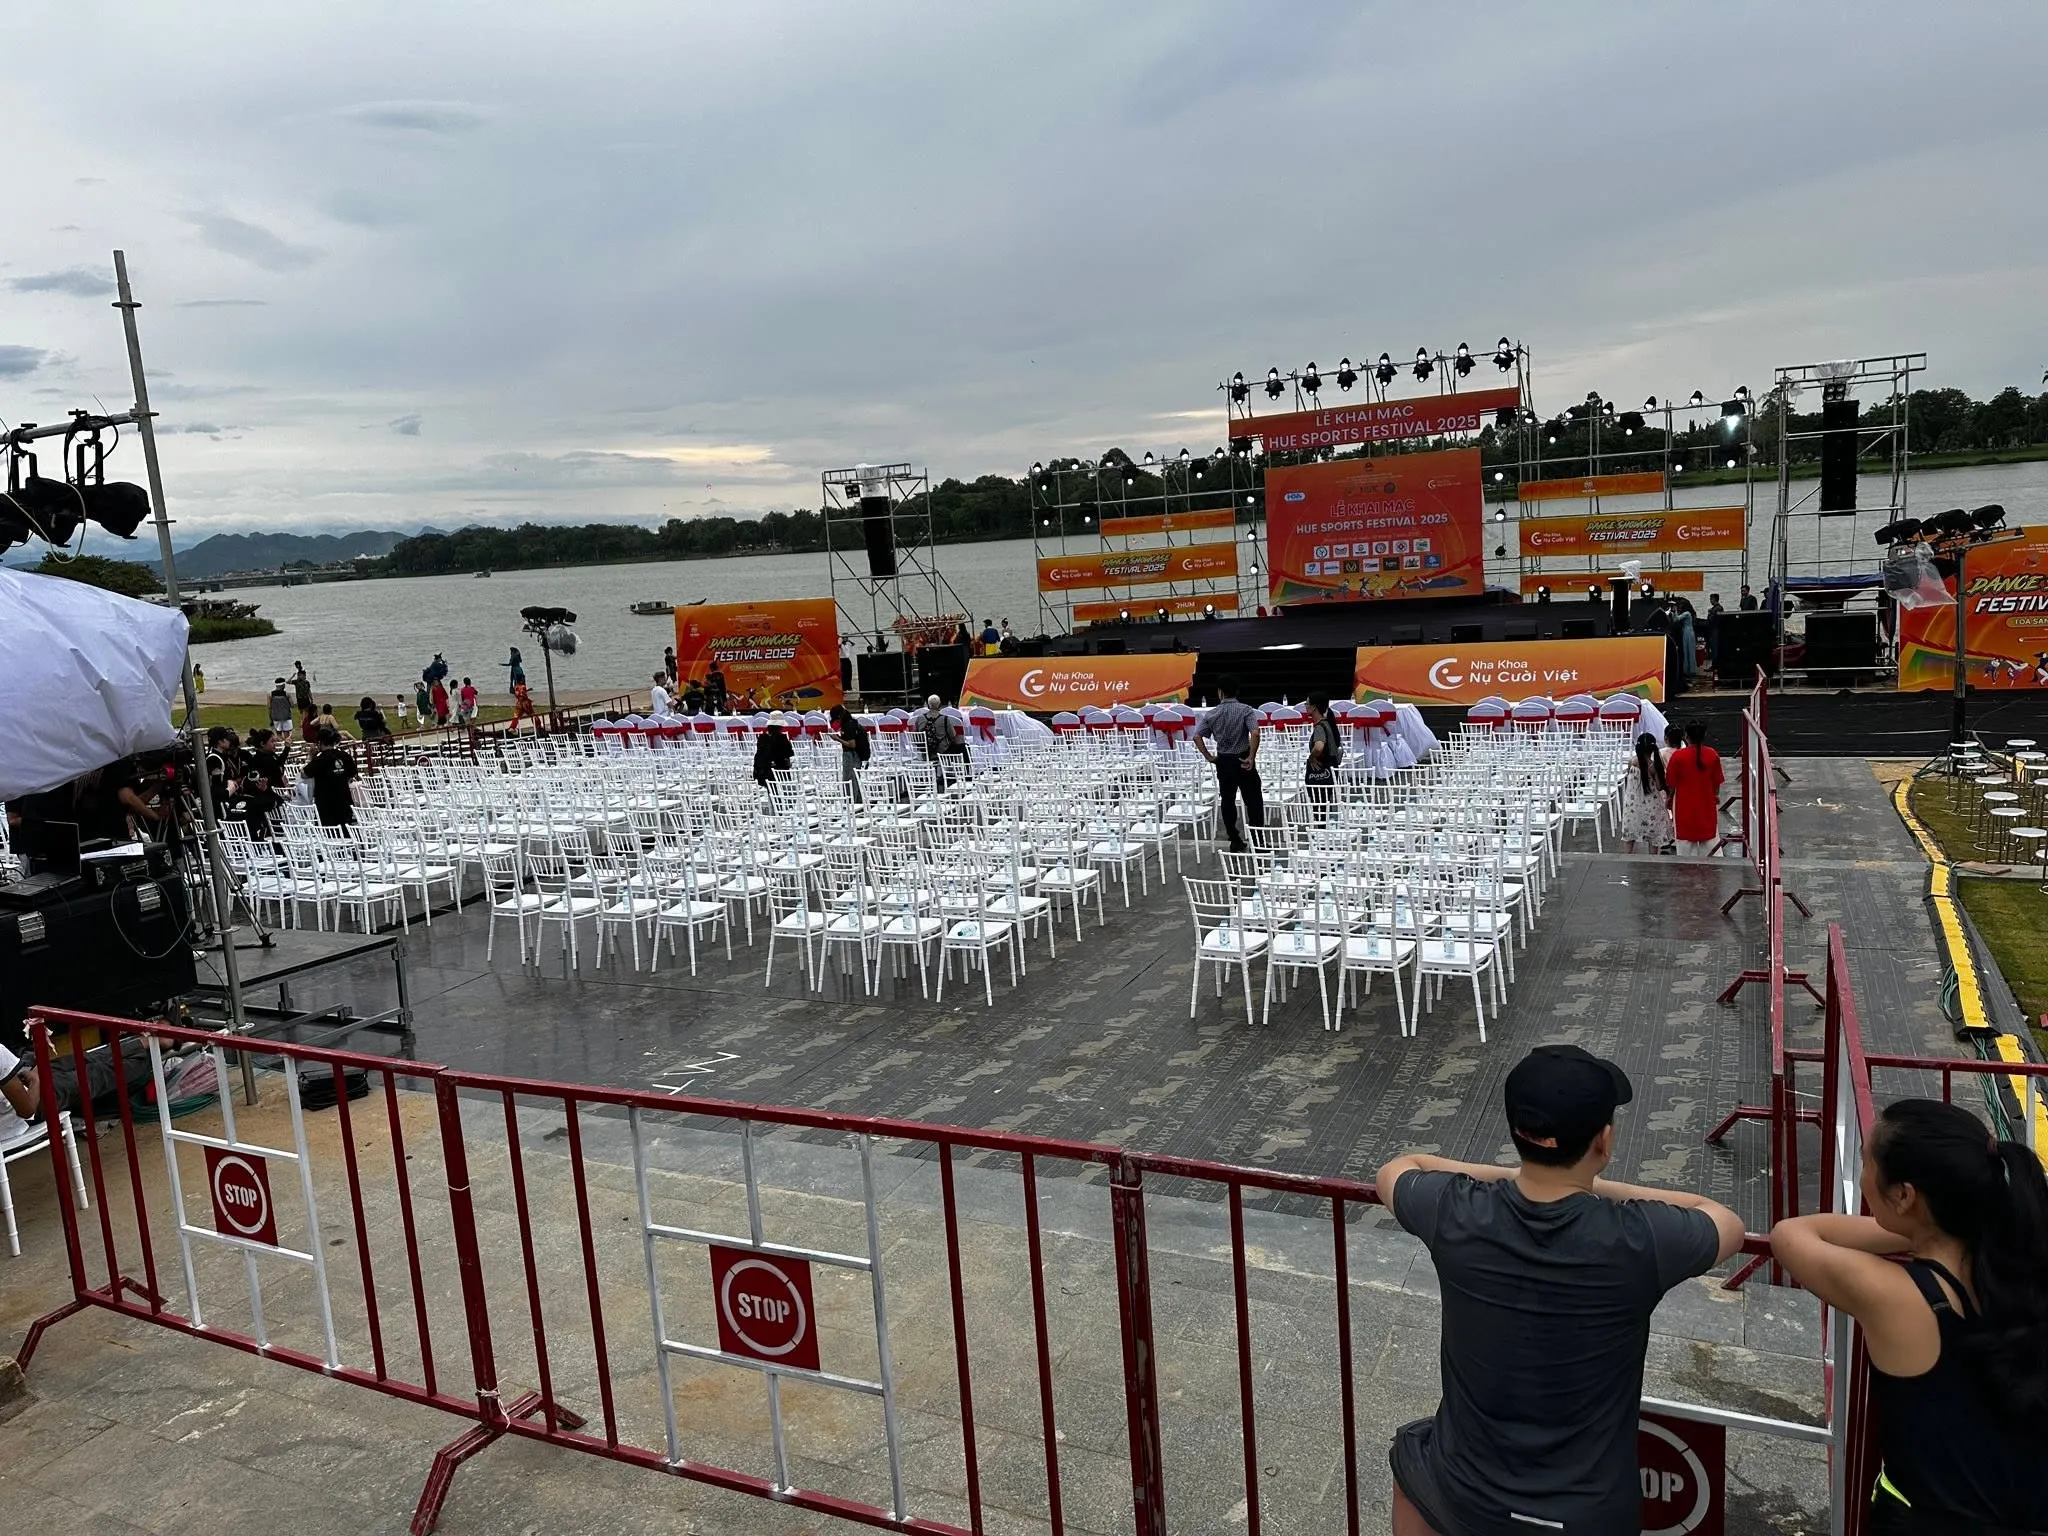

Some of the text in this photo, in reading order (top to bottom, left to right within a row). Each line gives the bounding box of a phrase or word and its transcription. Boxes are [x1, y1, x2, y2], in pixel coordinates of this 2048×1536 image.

[1335, 406, 1373, 425] KHAI
[1377, 405, 1415, 423] MẠC
[1269, 414, 1478, 449] HUE SPORTS FESTIVAL 2025
[1348, 501, 1380, 516] KHAI
[1296, 513, 1448, 535] HUE SPORTS FESTIVAL 2025
[1588, 529, 1657, 541] FESTIVAL 2025
[1104, 563, 1166, 575] FESTIVAL 2025
[1966, 574, 2044, 594] DANCE
[708, 634, 802, 649] DANCE SHOWCASE
[713, 647, 796, 661] FESTIVAL 2025
[1471, 659, 1528, 670] Nha Khoa
[1051, 671, 1094, 680] Nha Khoa
[1469, 669, 1579, 685] Nụ Cười Việt
[1048, 680, 1130, 694] Nụ Cười Việt
[224, 1183, 258, 1209] STOP
[737, 1292, 791, 1324] STOP
[1639, 1467, 1684, 1503] OP
